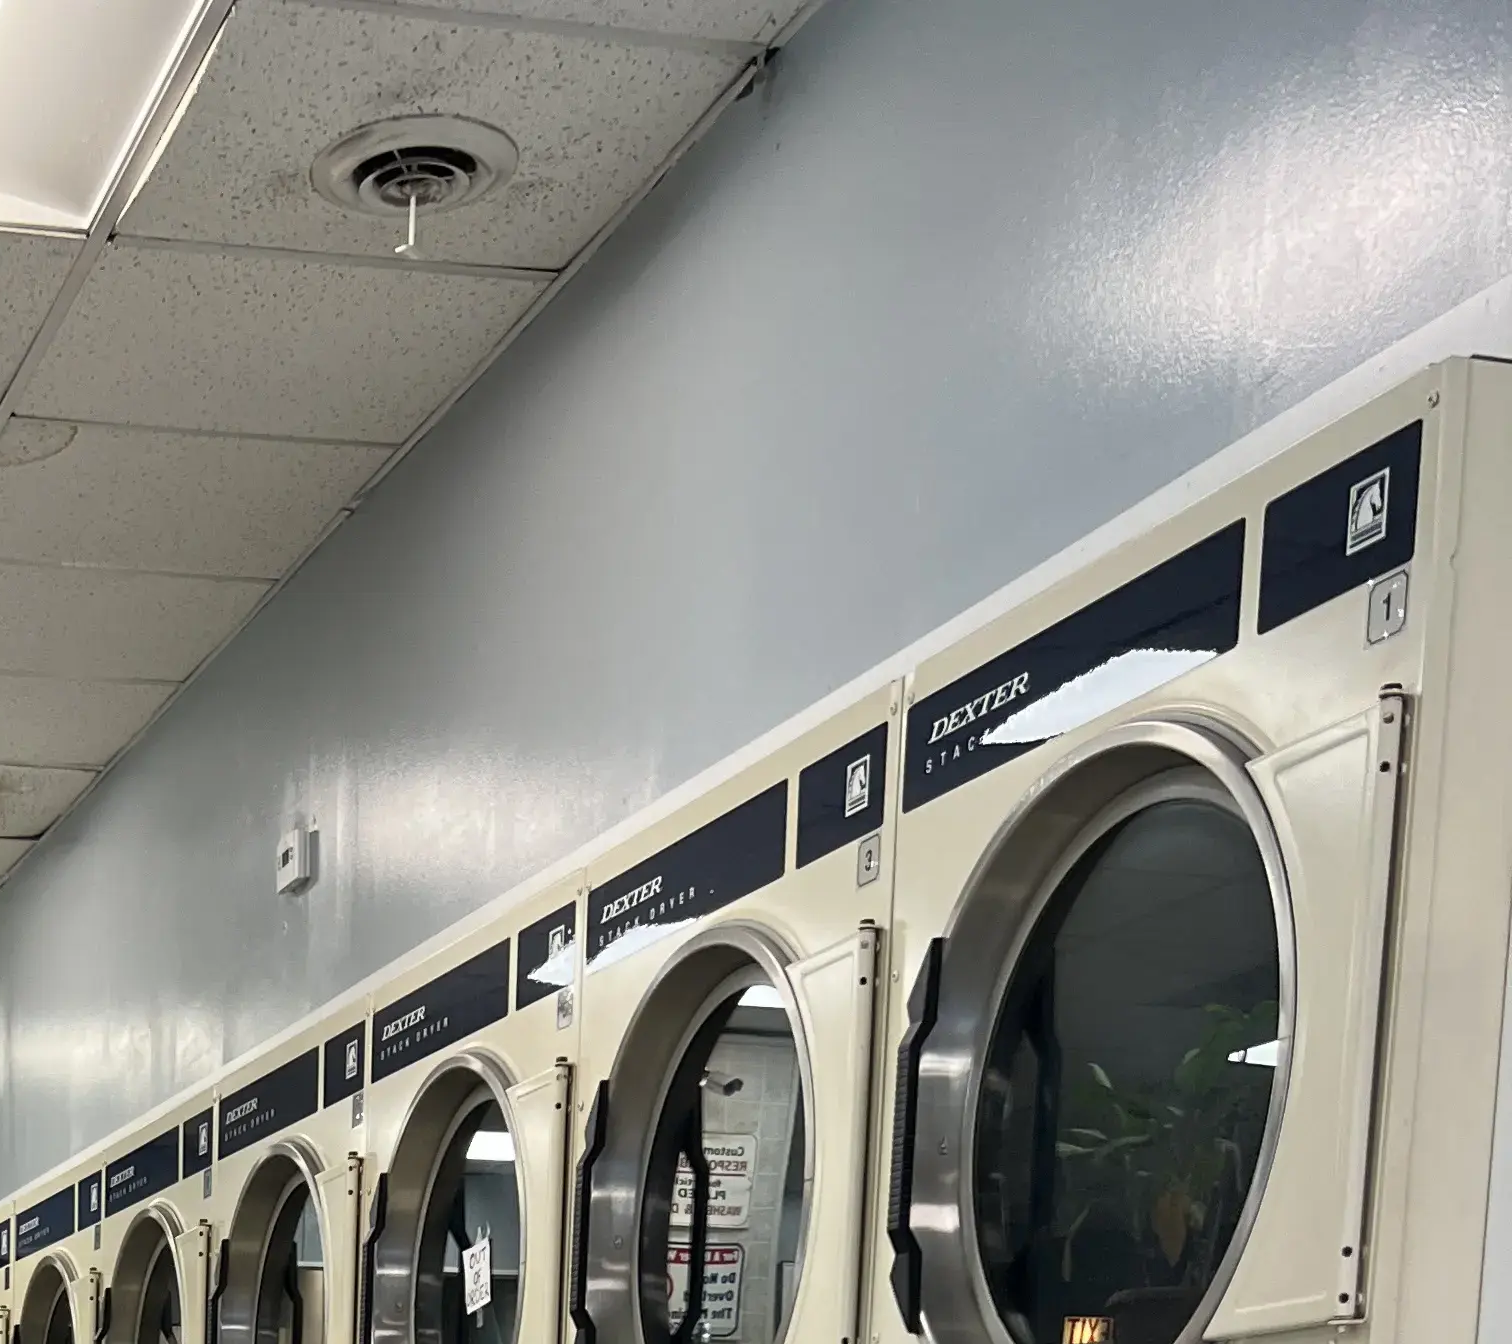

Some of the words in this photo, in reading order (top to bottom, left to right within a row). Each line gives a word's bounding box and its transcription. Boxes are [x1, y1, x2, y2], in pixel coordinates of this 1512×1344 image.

[1382, 591, 1392, 622] 1
[927, 671, 1029, 745] DEXTER
[864, 849, 873, 872] 3
[599, 875, 663, 924] DEXTER
[381, 1005, 426, 1042] DEXTER
[225, 1097, 258, 1125] DEXTER
[468, 1247, 487, 1270] OUT
[472, 1269, 482, 1286] OF
